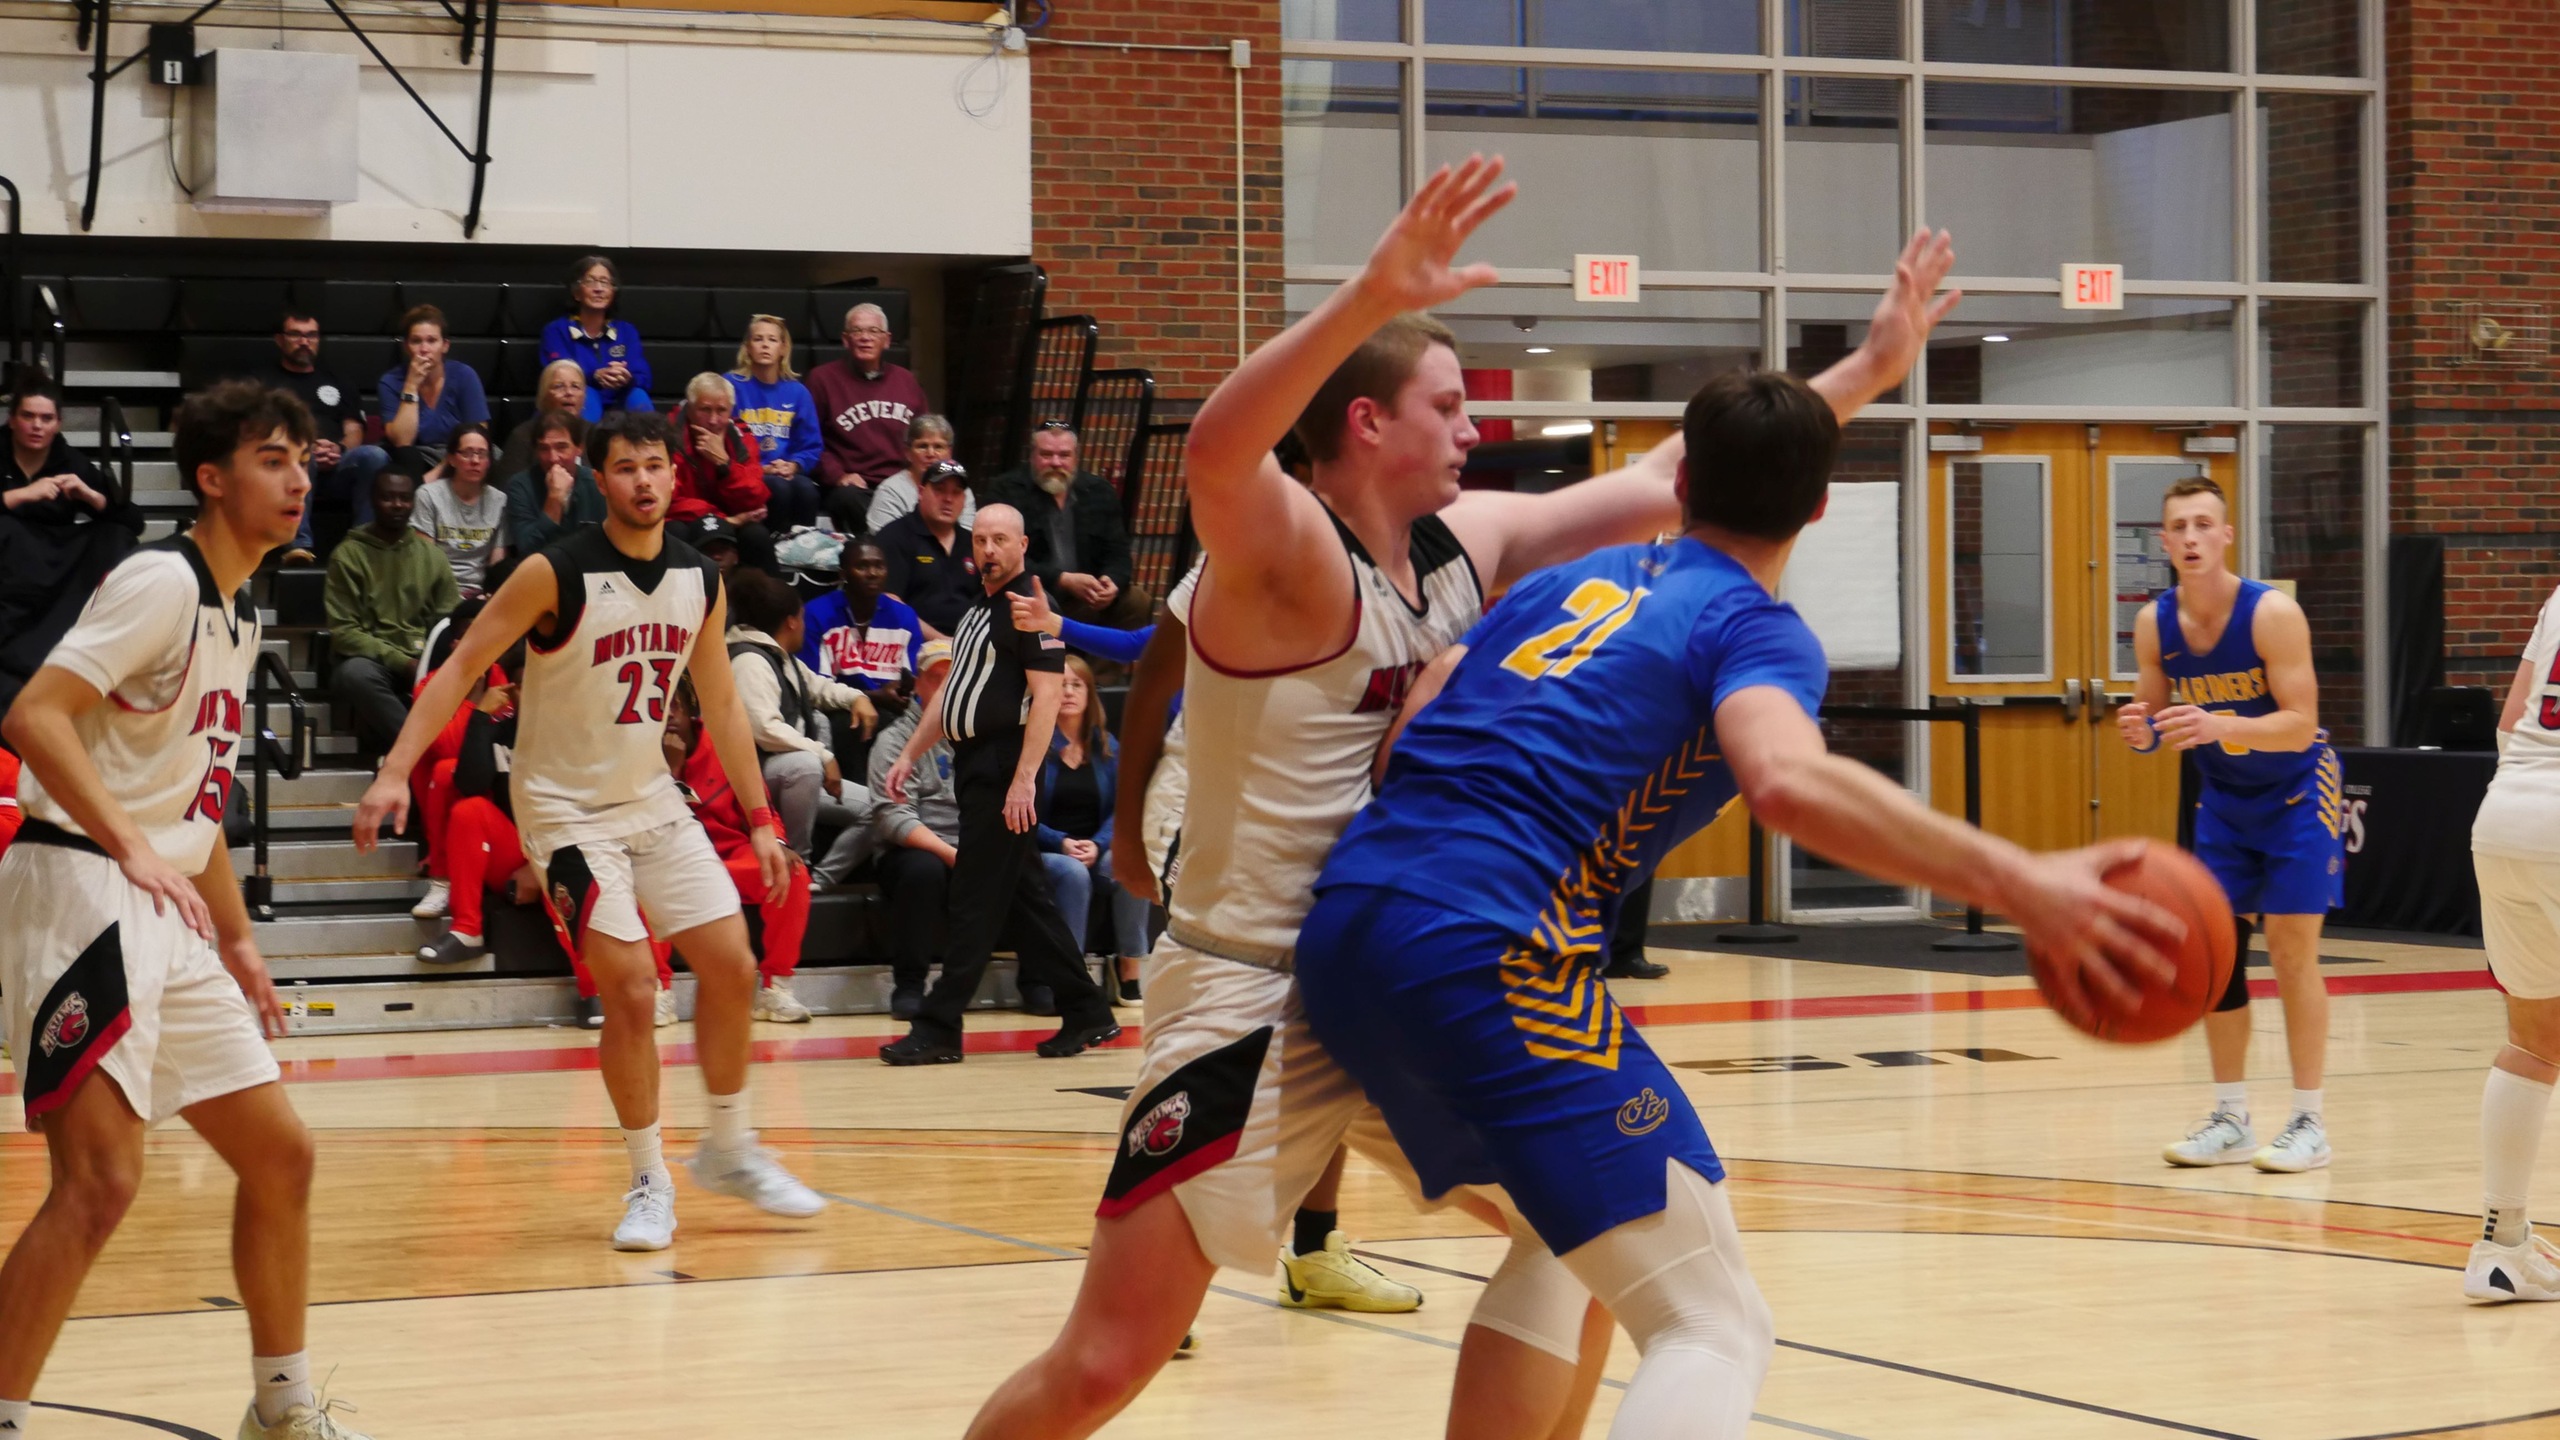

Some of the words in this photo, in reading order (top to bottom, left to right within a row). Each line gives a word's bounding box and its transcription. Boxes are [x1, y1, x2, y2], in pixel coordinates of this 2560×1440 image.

[168, 62, 178, 82] 1
[1589, 261, 1628, 296] EXIT
[2077, 270, 2113, 303] EXIT
[835, 399, 915, 432] STEVENS
[591, 622, 694, 668] MUSTANG
[1498, 577, 1653, 681] 21
[614, 658, 677, 725] 23
[183, 736, 233, 825] 15
[1127, 1090, 1191, 1158] MUSTANGS
